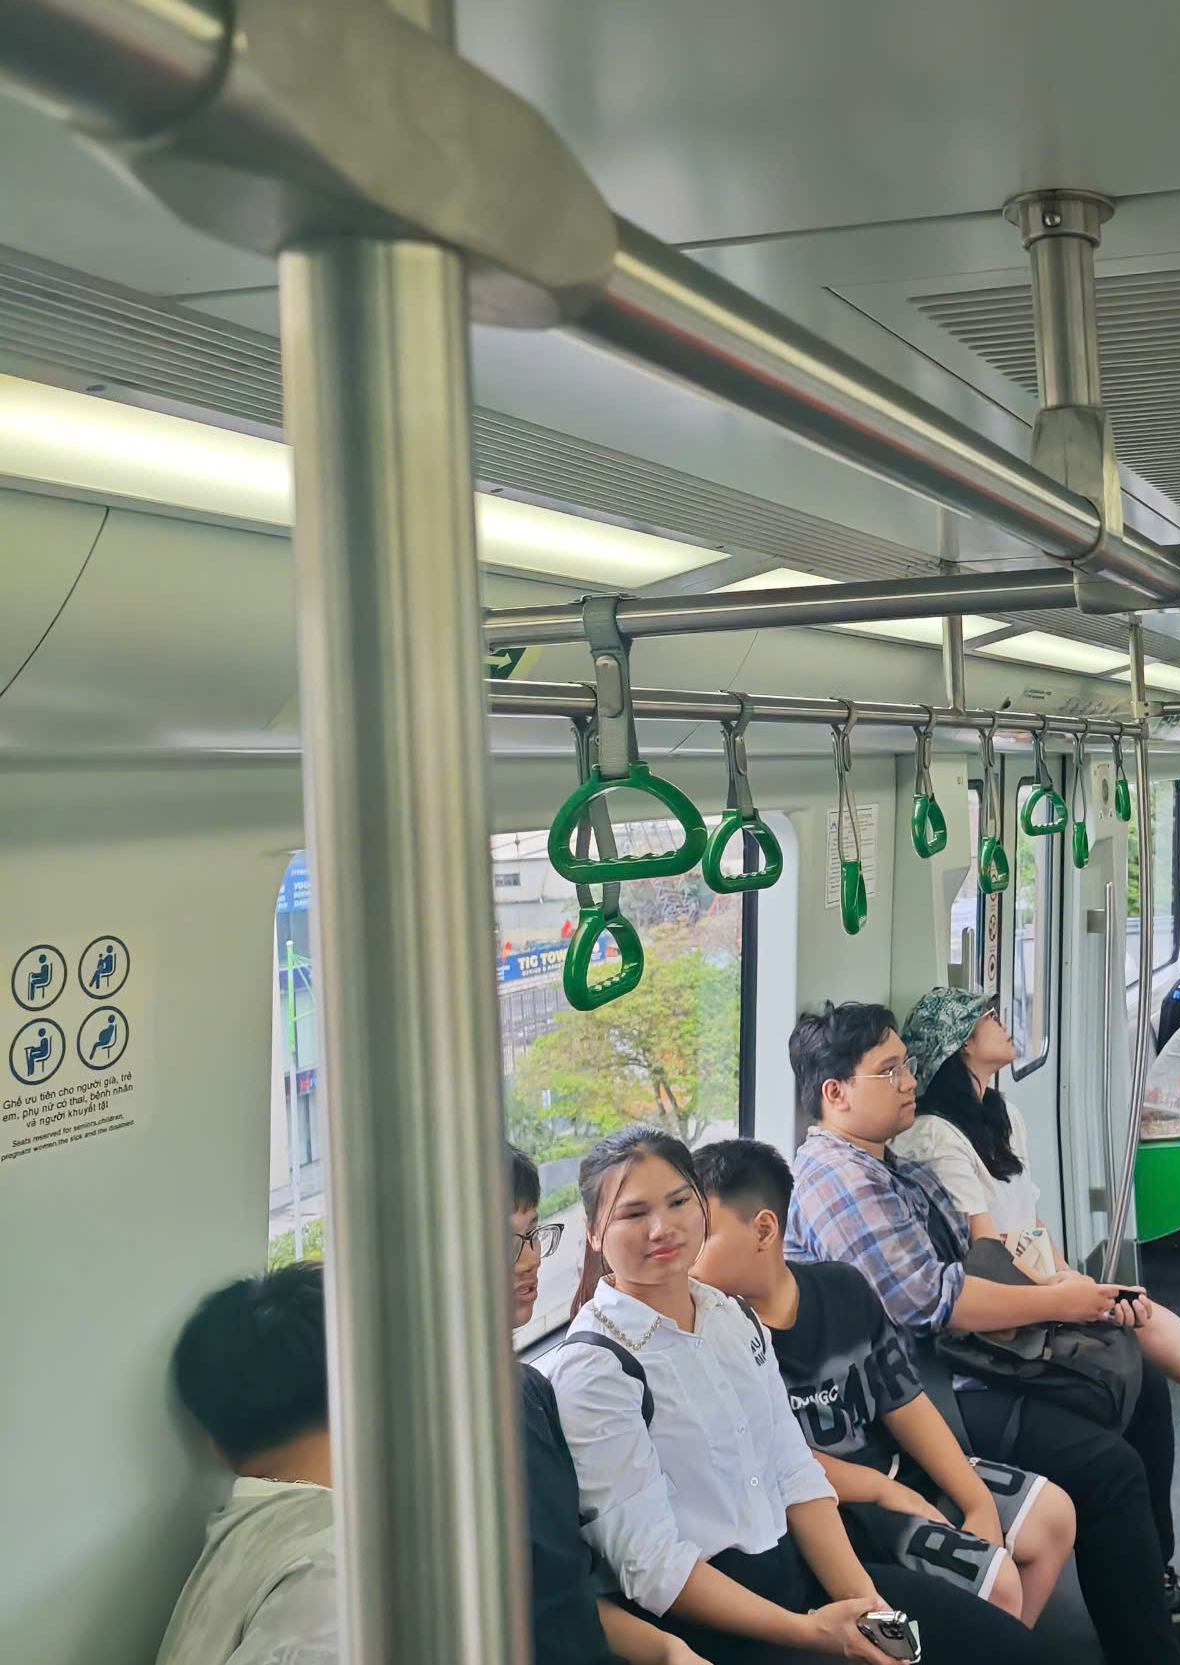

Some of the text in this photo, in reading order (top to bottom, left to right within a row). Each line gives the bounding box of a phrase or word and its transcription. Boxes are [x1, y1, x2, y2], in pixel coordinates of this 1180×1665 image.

[22, 1107, 39, 1120] phụ
[42, 1102, 54, 1113] nữ
[57, 1099, 67, 1109] có
[90, 1089, 111, 1101] bệnh
[113, 1084, 133, 1095] nhân
[25, 1096, 37, 1105] ưu
[40, 1091, 56, 1101] tiên
[59, 1086, 75, 1097] cho
[77, 1080, 101, 1094] người
[121, 1071, 132, 1082] trẻ
[26, 1100, 109, 1128] và người khuyết tật
[1, 1148, 31, 1162] pregnant
[70, 1134, 82, 1142] sick
[85, 1130, 97, 1138] and
[109, 1120, 134, 1132] disabled
[12, 1138, 31, 1148] Seats
[33, 1129, 61, 1142] reserved
